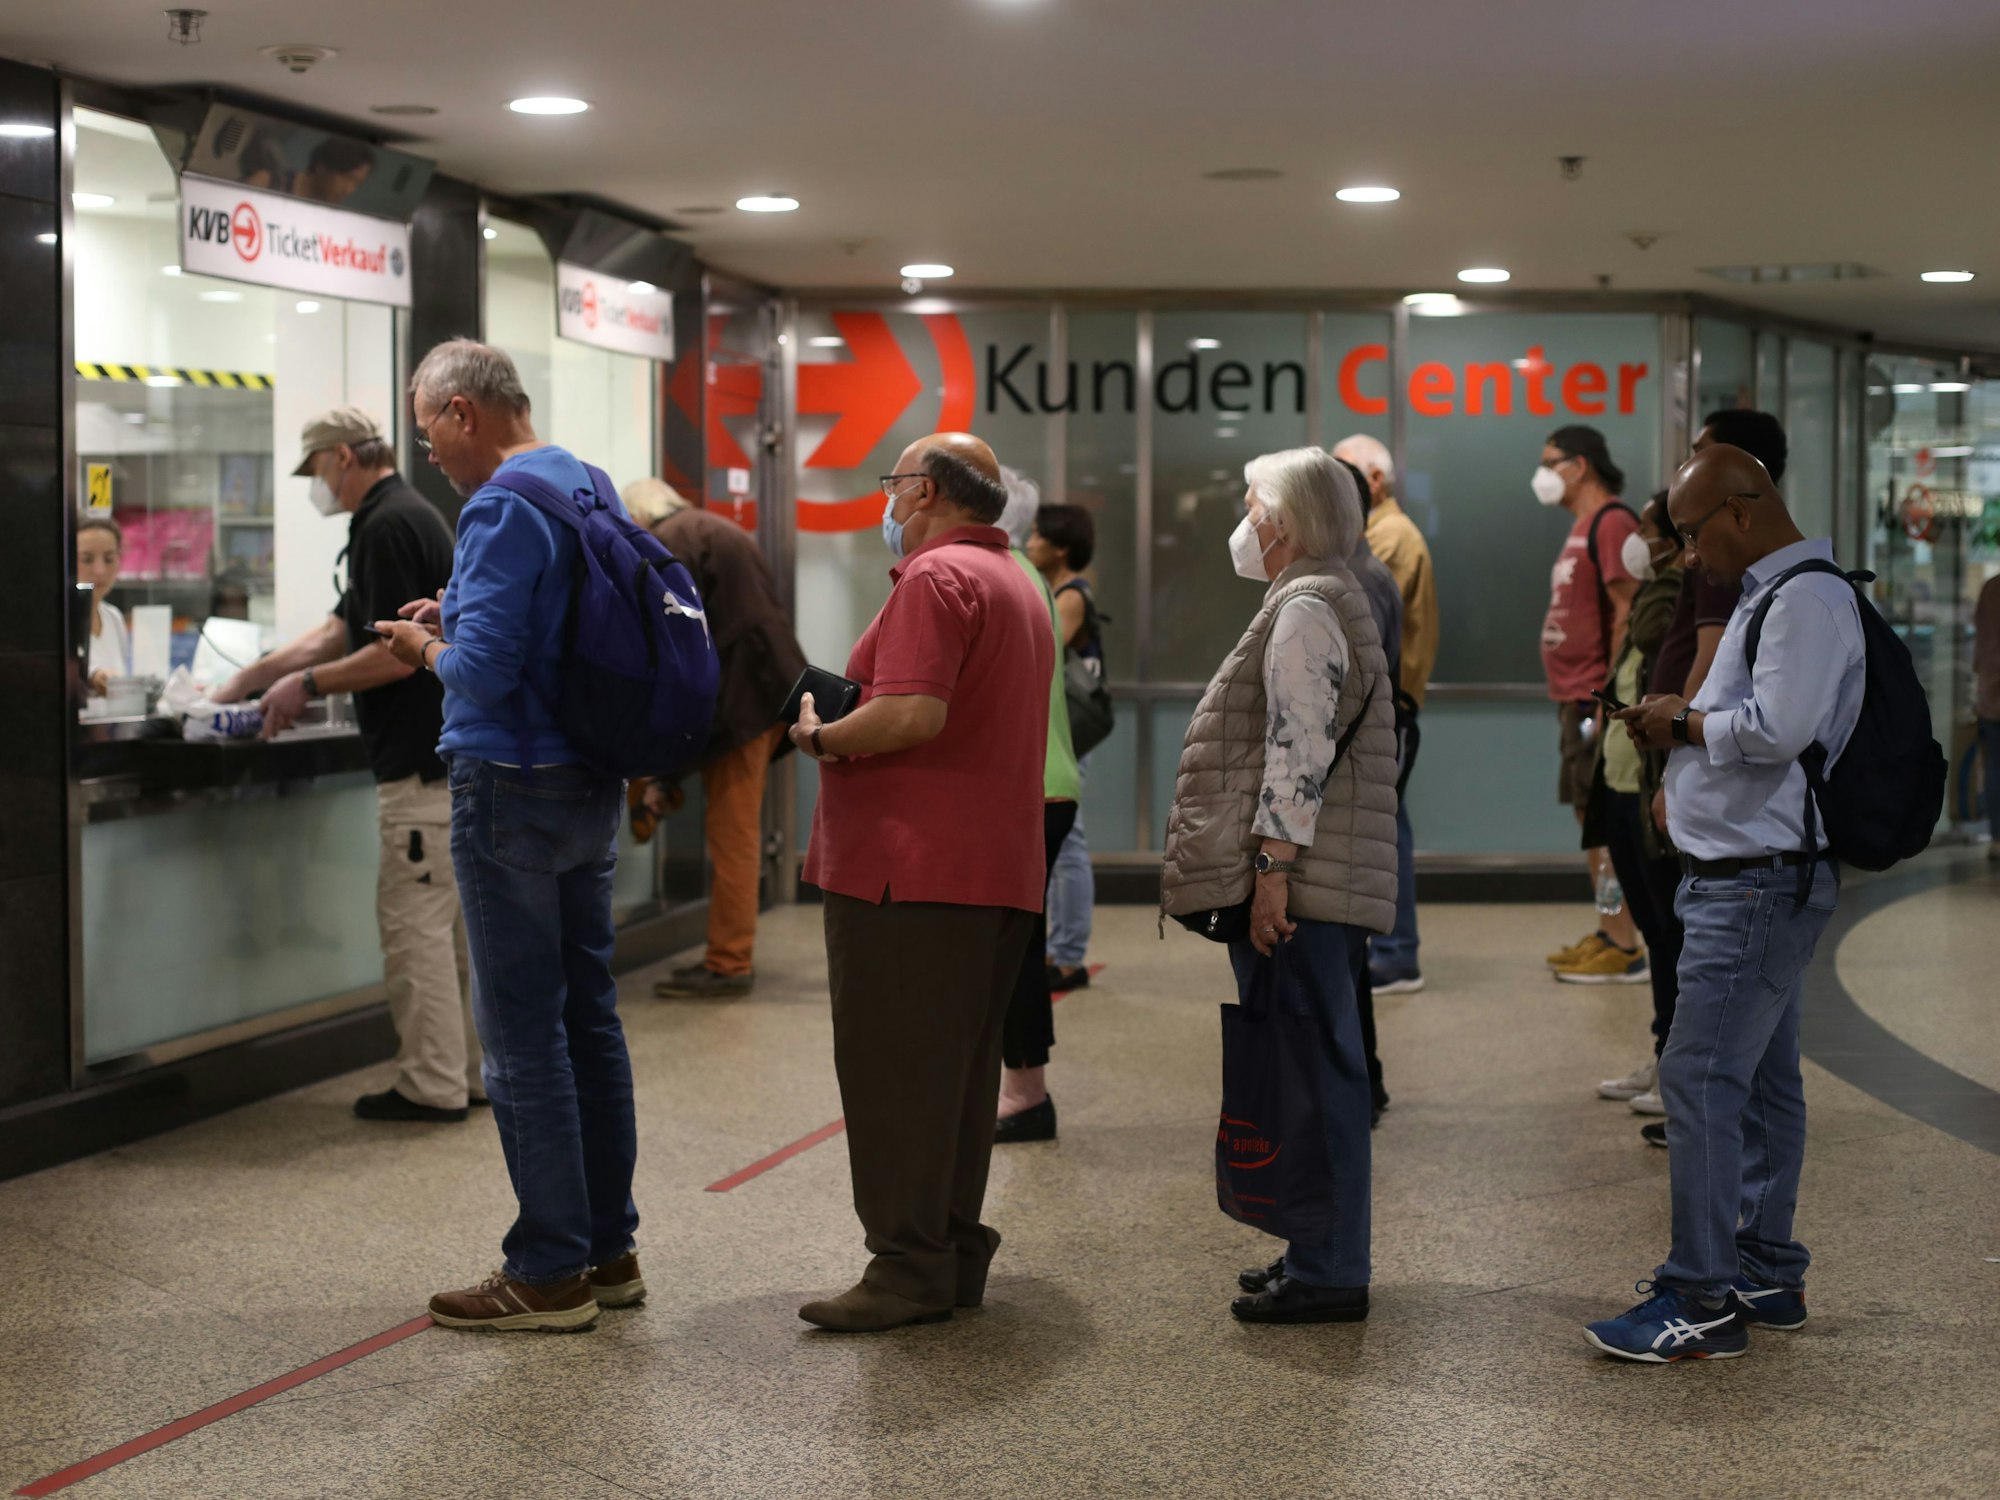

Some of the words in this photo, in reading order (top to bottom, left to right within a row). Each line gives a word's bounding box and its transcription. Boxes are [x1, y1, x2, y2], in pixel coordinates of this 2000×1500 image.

[189, 206, 230, 245] KVB
[986, 344, 1306, 413] Kunden
[1337, 343, 1649, 416] Center
